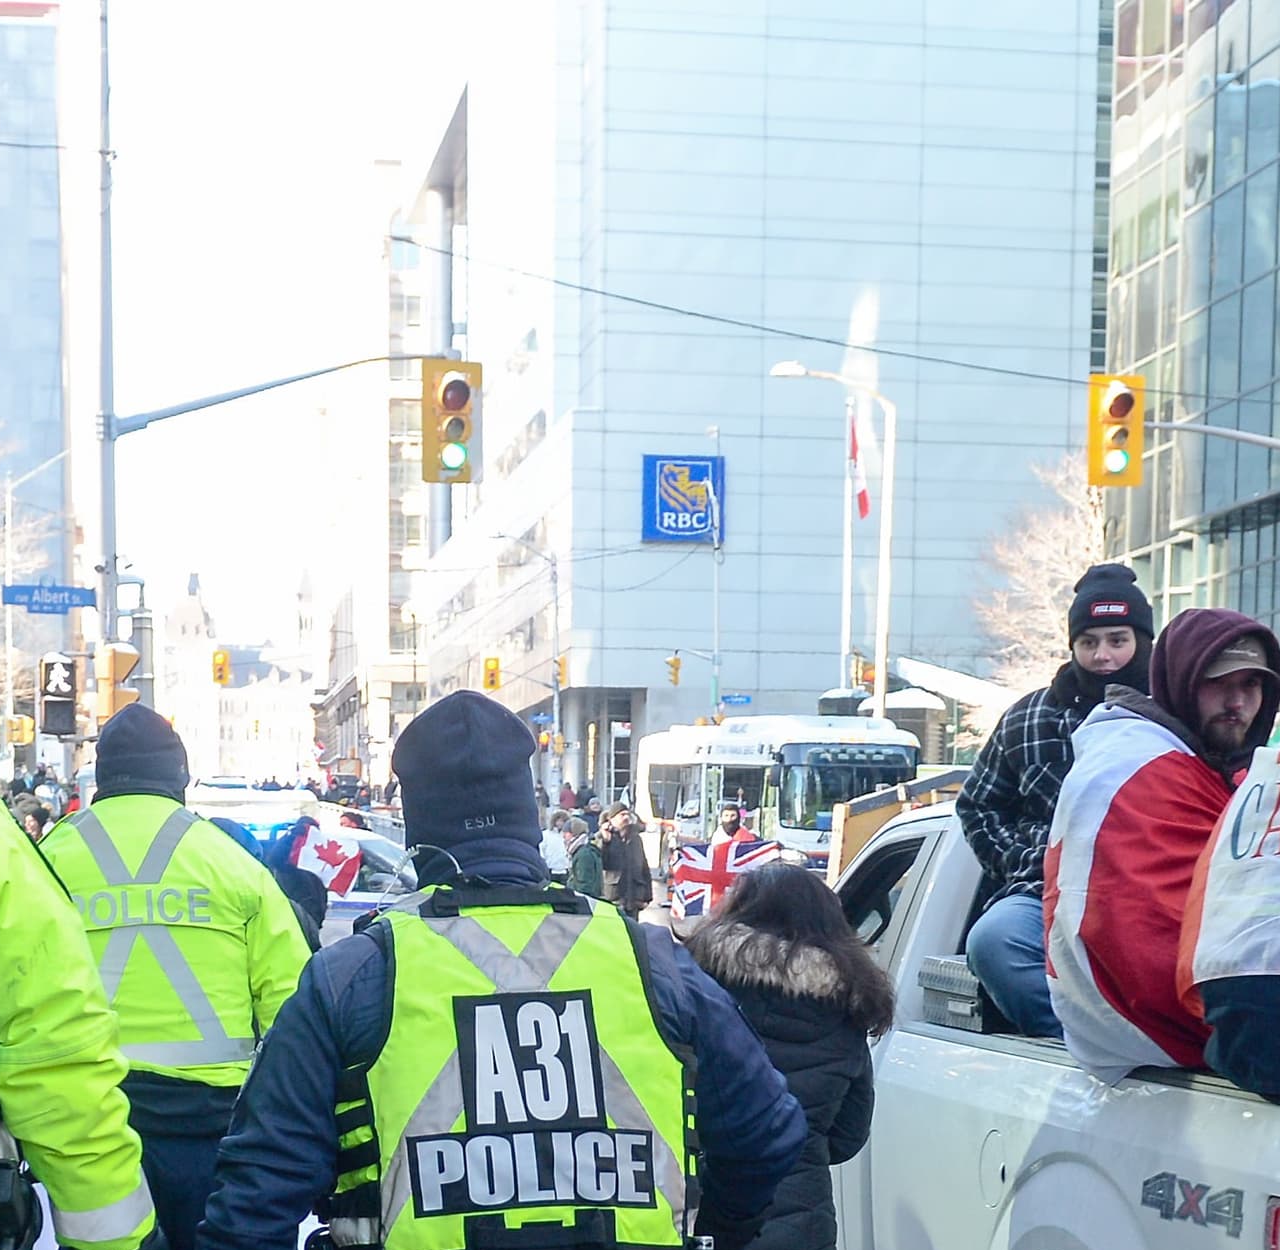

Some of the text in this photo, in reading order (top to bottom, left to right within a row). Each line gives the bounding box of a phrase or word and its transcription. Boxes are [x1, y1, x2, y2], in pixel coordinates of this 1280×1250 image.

[662, 511, 706, 529] RBC
[31, 587, 70, 605] Albert
[474, 999, 599, 1126] A31
[415, 1131, 651, 1212] POLICE
